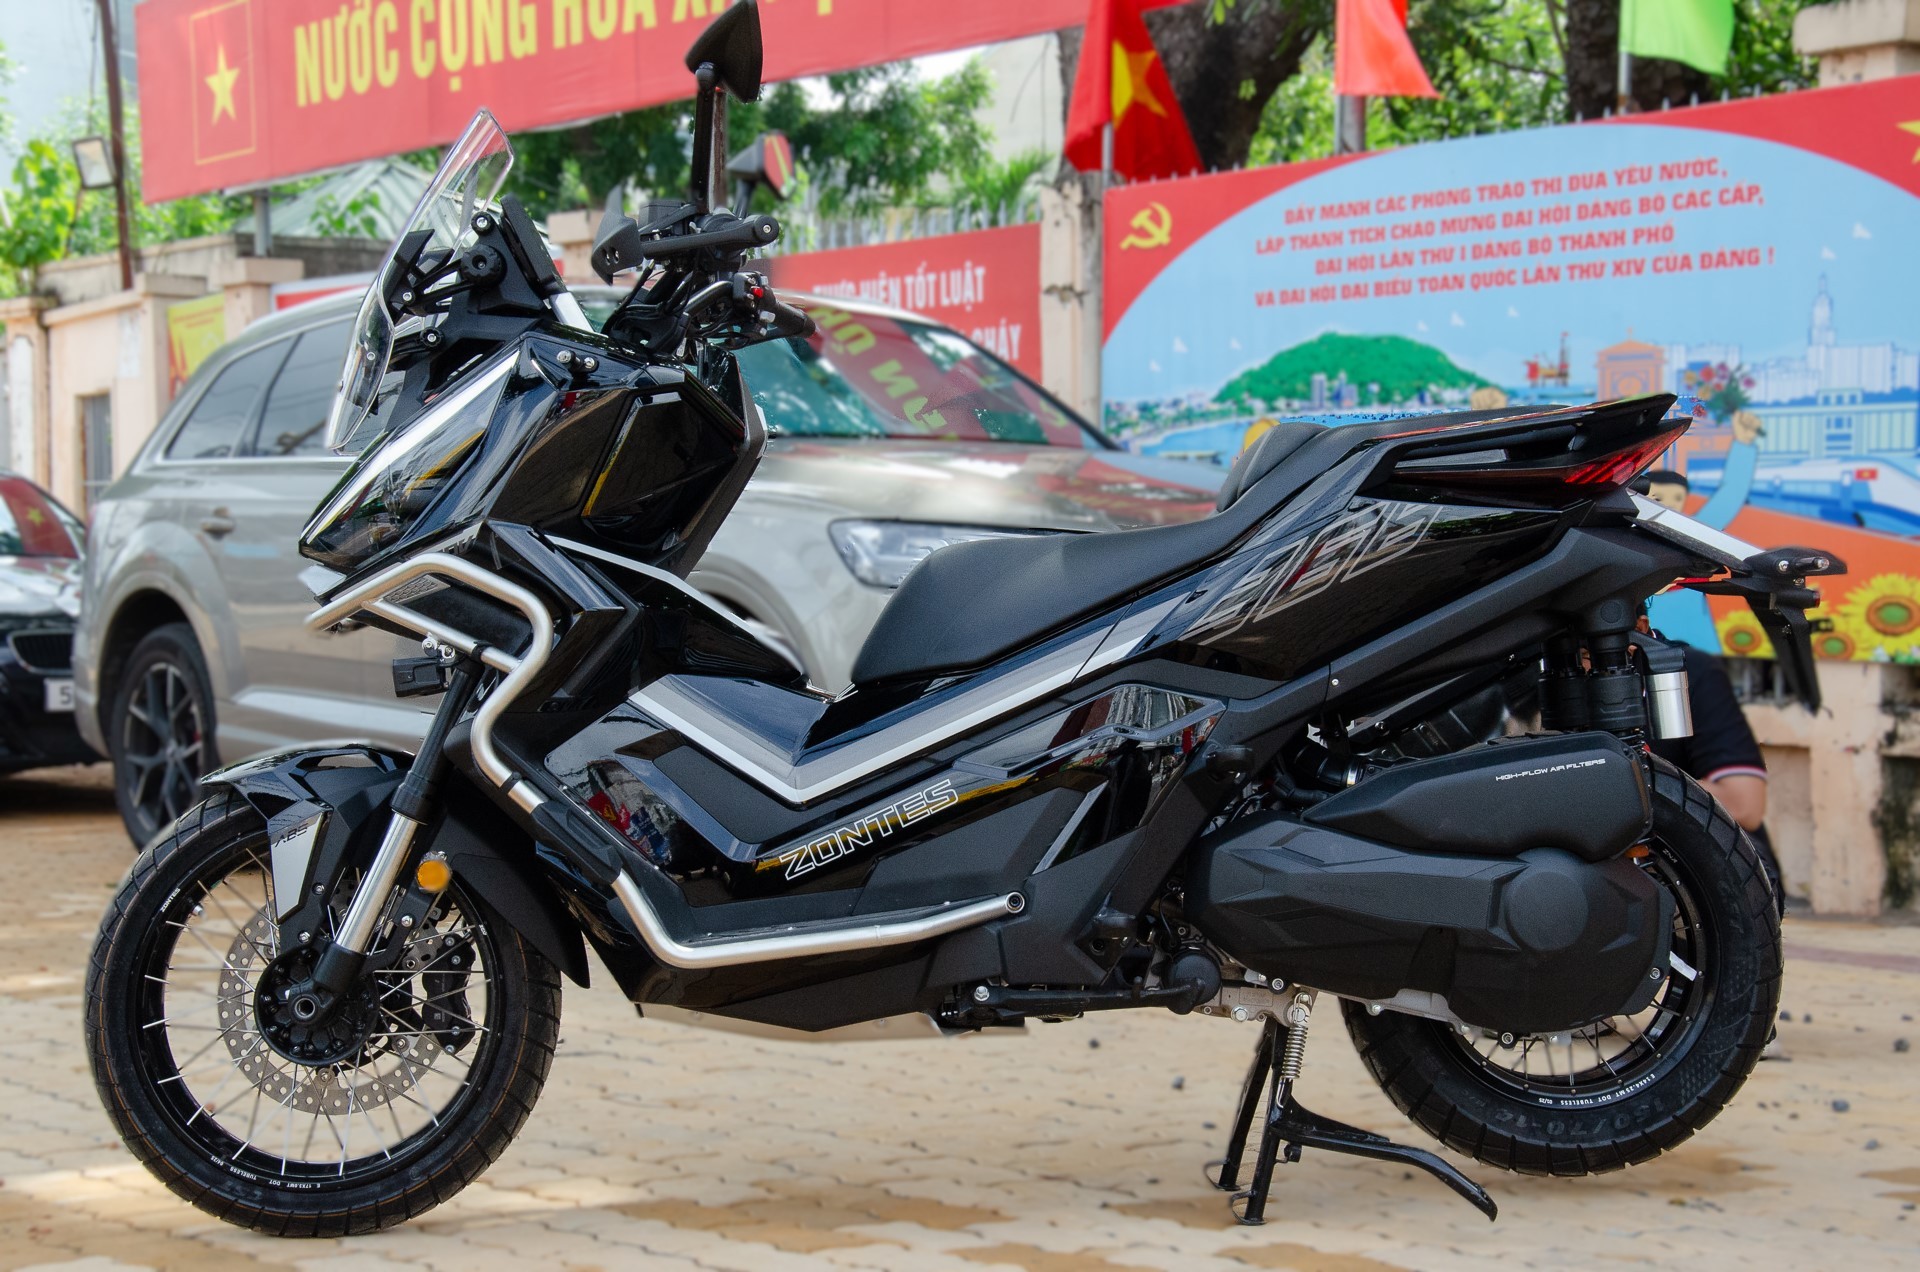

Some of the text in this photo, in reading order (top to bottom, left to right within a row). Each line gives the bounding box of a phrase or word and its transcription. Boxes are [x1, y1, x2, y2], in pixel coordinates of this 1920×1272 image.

[1411, 187, 1472, 210] PHONG
[1530, 176, 1563, 196] THI
[1612, 257, 1647, 277] XIV
[904, 261, 936, 309] TỐT
[940, 260, 985, 311] LUẬT
[1495, 758, 1606, 781] HIGH-FLOW AIR FILTERS
[274, 823, 308, 848] ABS
[779, 778, 959, 881] ZONTES
[160, 887, 181, 912] ZONTES
[1560, 1098, 1594, 1106] TUBELESS
[1598, 1094, 1612, 1103] DOT
[229, 1166, 257, 1180] TUBELESS
